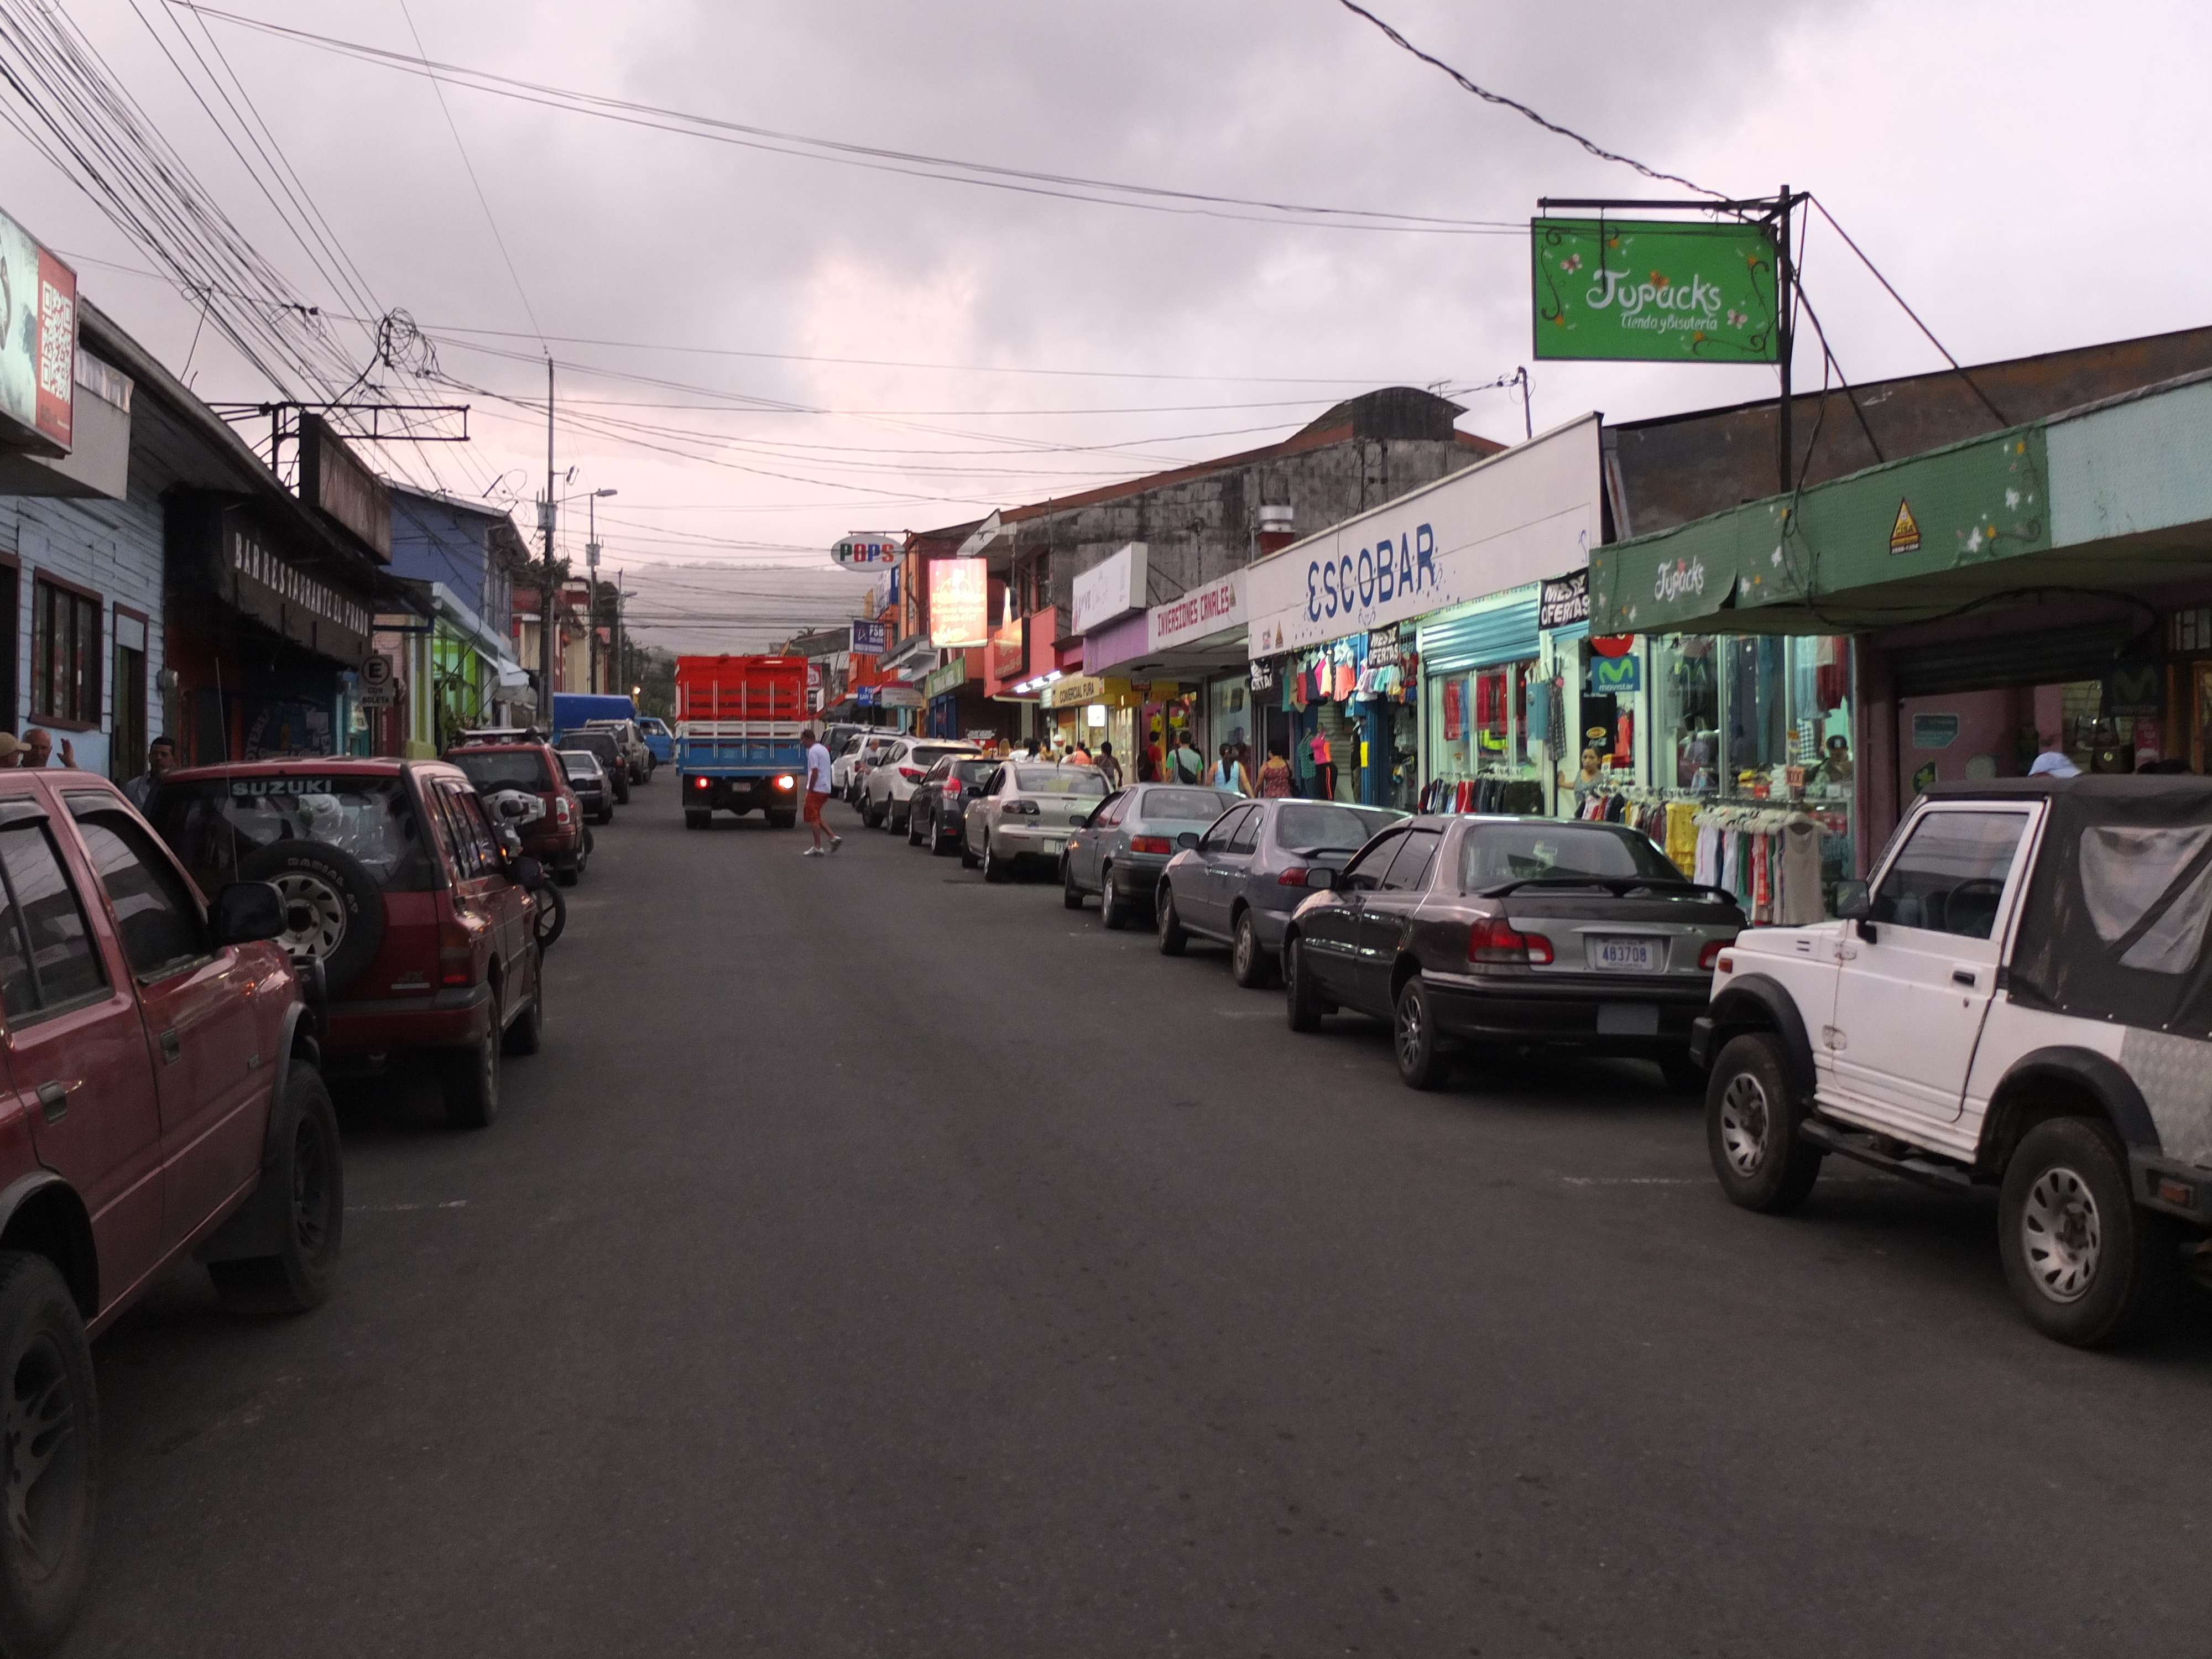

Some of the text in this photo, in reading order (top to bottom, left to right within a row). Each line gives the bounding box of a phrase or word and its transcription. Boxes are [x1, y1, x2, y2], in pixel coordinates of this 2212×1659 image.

[840, 543, 894, 562] POPS
[234, 531, 369, 637] BAR RESTAURANTE EL PRADO
[1308, 523, 1434, 622] ESCOBAR
[1157, 598, 1198, 637] INVERSIONES
[1541, 594, 1590, 625] OFERTAS
[1368, 643, 1399, 666] OFERTAS
[369, 663, 382, 679] E
[232, 779, 332, 796] SUZUKI
[288, 857, 344, 886] RADIAL
[1603, 946, 1647, 963] 483708
